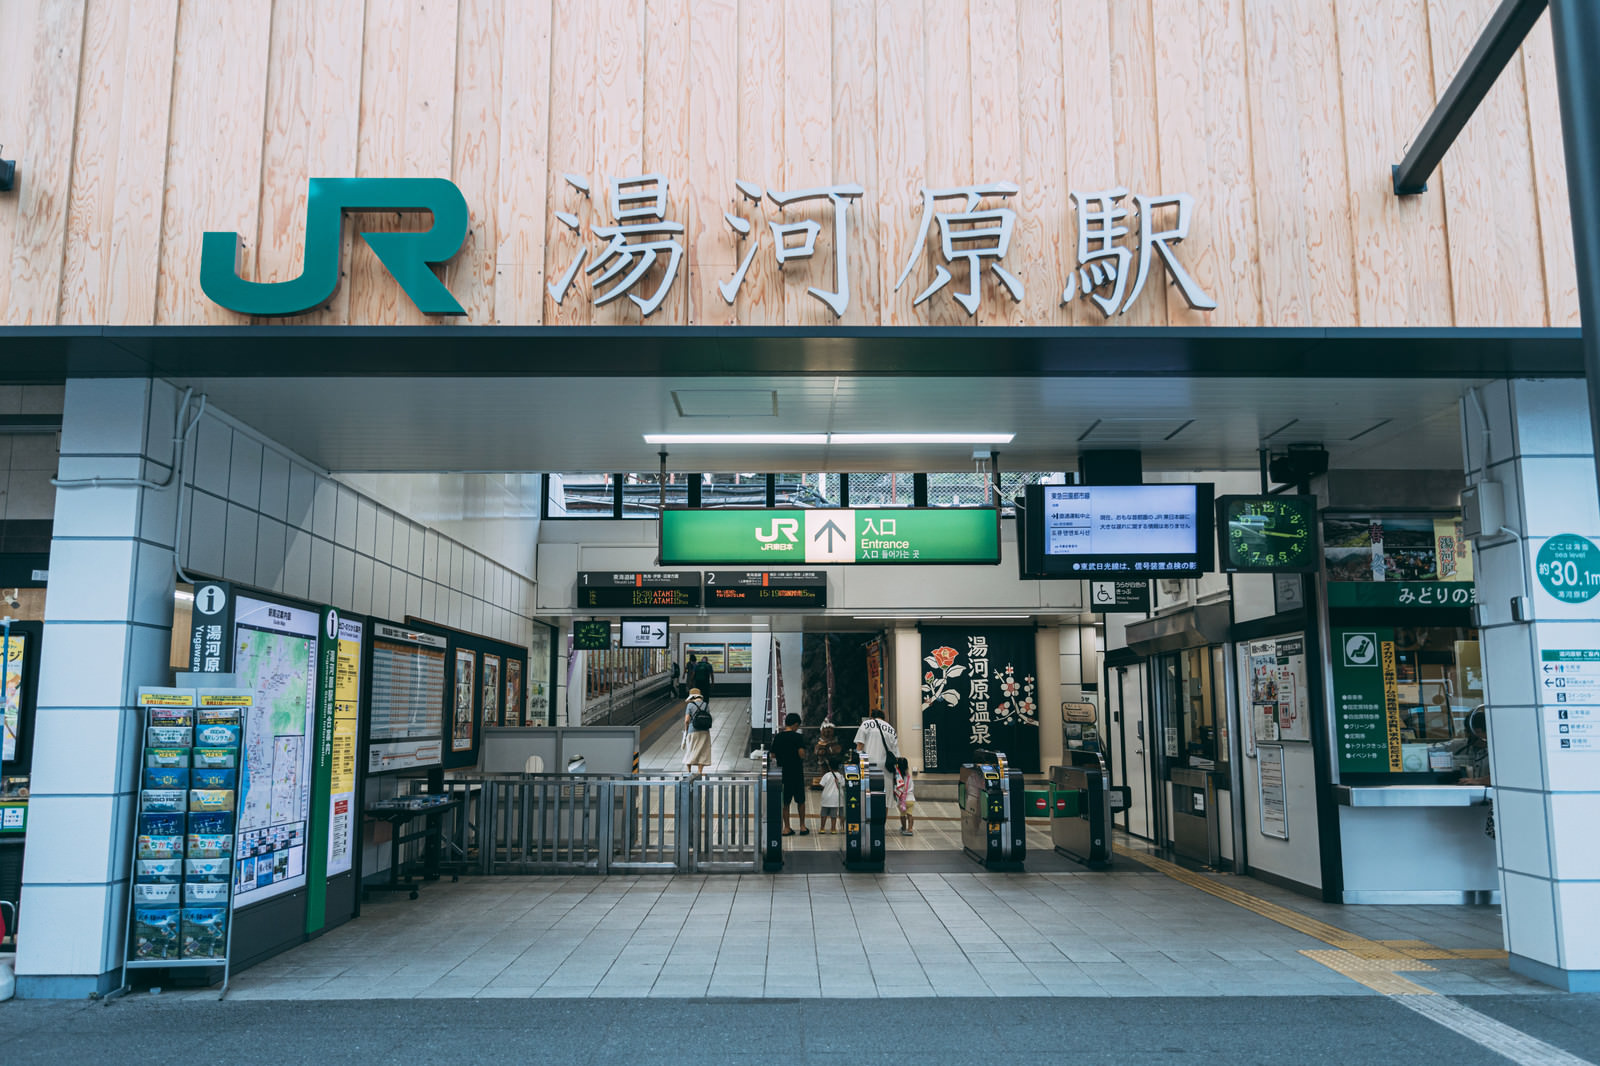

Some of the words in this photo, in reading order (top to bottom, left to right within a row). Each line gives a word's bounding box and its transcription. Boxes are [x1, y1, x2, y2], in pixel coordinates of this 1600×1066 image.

[201, 177, 470, 317] JR
[548, 172, 1217, 318] 湯河原駅
[1251, 508, 1260, 516] 11
[755, 518, 799, 542] JR
[862, 518, 896, 536] 入口
[760, 543, 794, 551] JR東日本
[861, 539, 910, 549] Entrance
[1240, 543, 1248, 551] 8
[1291, 543, 1299, 551] 4
[861, 550, 879, 559] 入口
[882, 550, 910, 559] 들어가는
[1253, 552, 1260, 560] 7
[1266, 554, 1274, 562] 6
[1279, 552, 1286, 560] 5
[583, 574, 588, 584] 1
[707, 573, 715, 584] 2
[653, 590, 674, 598] ATAMI
[193, 625, 204, 672] Yugawara
[205, 625, 221, 672] 湯河原
[967, 635, 991, 744] 湯河原温泉
